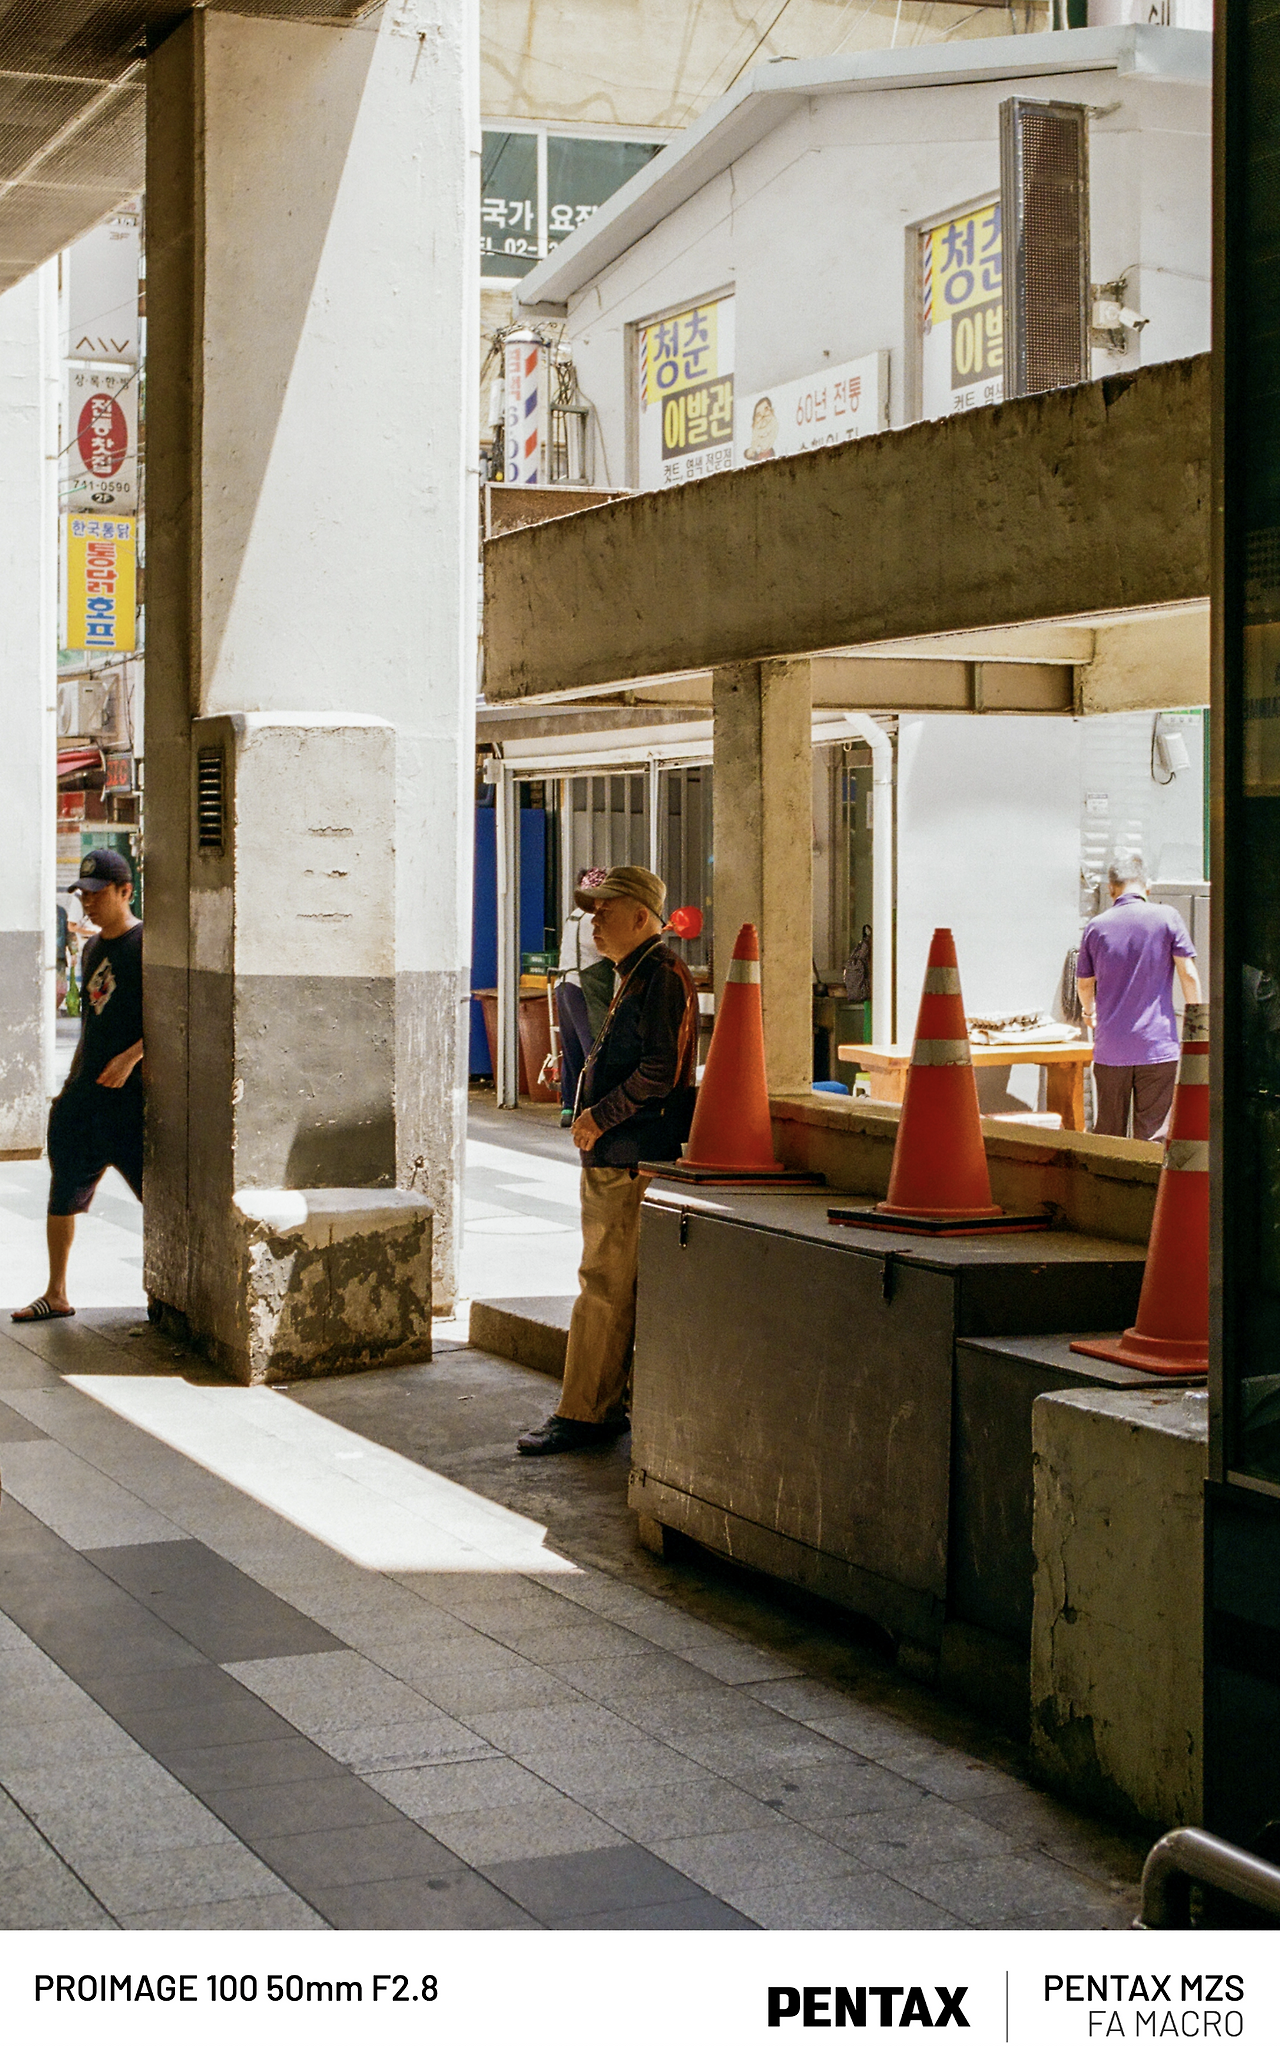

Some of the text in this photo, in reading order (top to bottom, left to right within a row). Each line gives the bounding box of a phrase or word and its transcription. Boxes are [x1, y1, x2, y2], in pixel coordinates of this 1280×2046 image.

[654, 310, 710, 389] 청춘
[664, 381, 734, 449] 이발관
[796, 376, 861, 426] 60년 전통
[706, 448, 732, 473] 전문점
[73, 480, 130, 493] 741-0590
[72, 519, 131, 541] 한국통닭
[86, 541, 117, 595] 통닭
[86, 596, 116, 646] 호프
